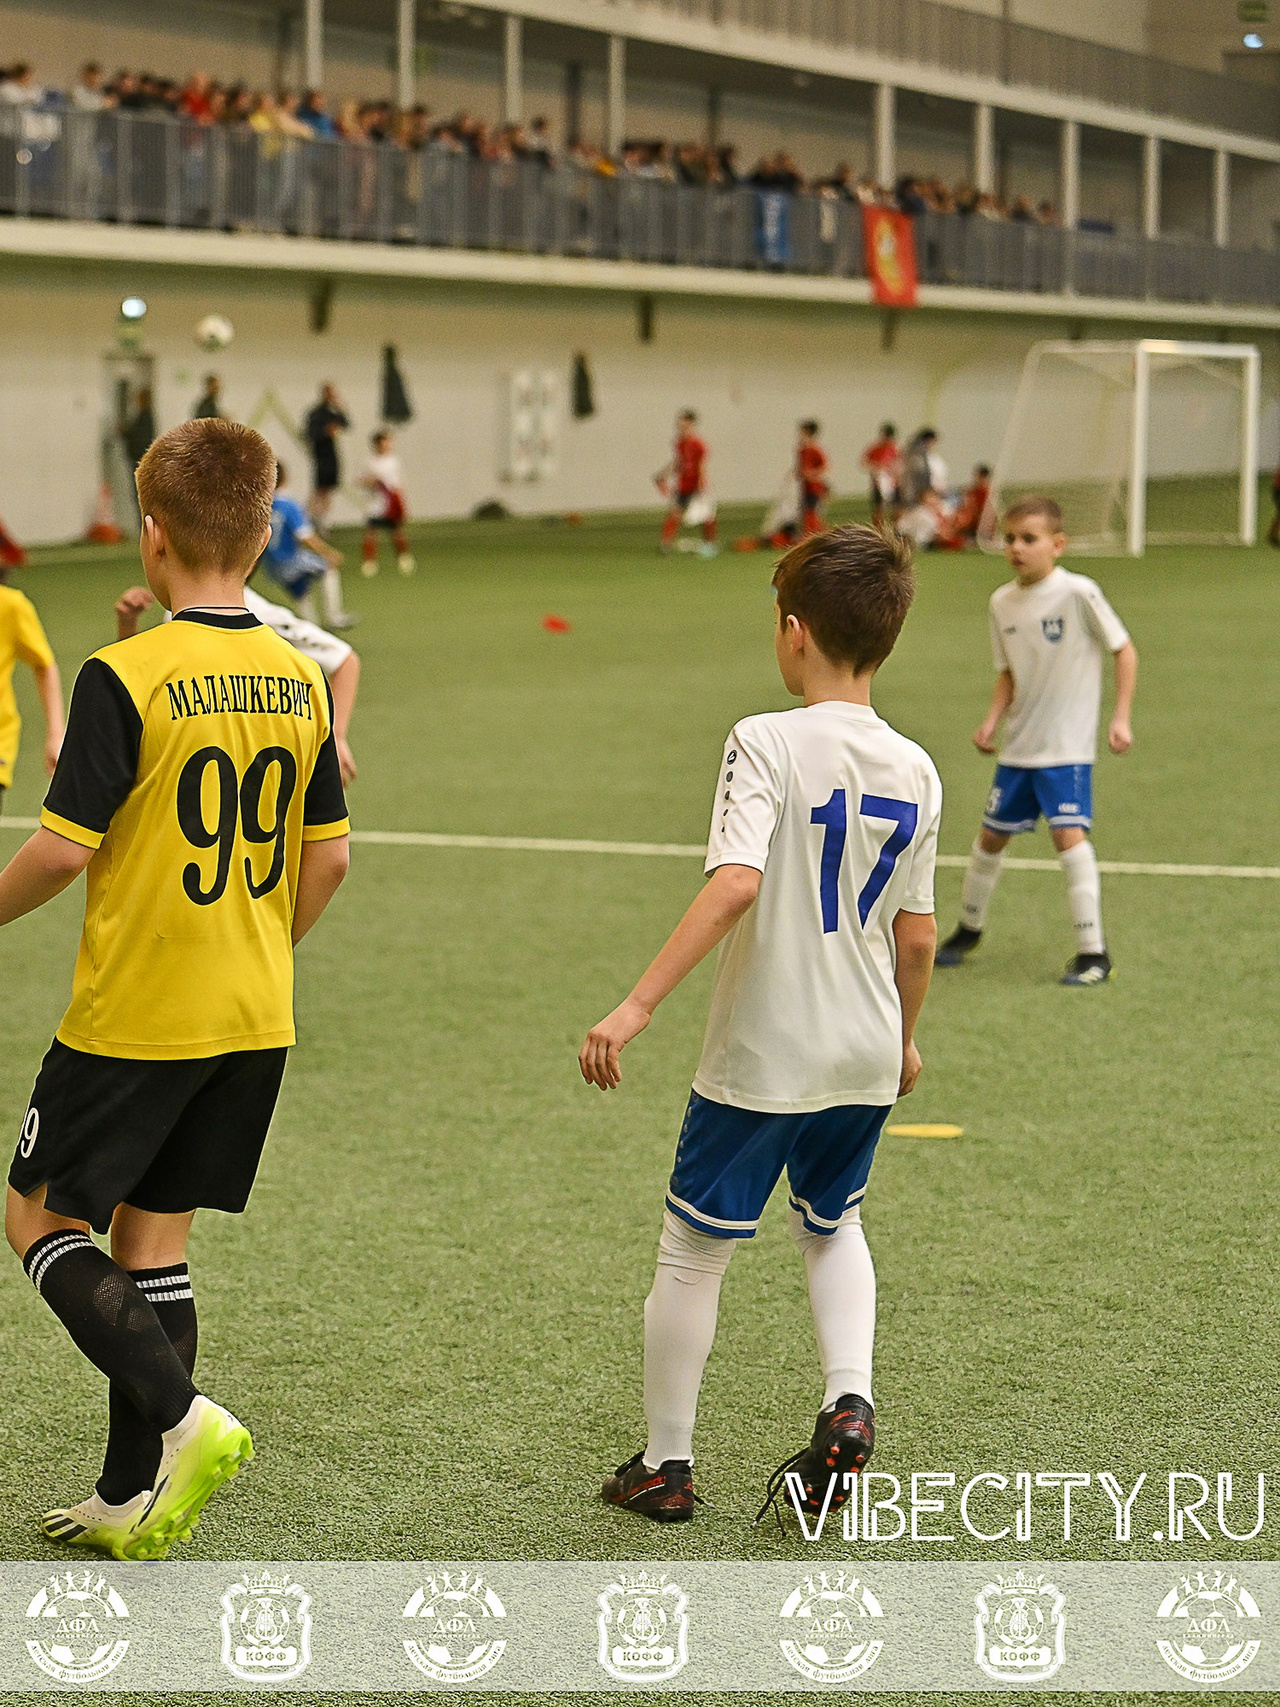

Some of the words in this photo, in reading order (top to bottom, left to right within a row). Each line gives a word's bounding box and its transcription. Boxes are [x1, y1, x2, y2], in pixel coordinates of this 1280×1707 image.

[166, 675, 312, 721] МАЛАШКЕВИЧ
[176, 746, 297, 906] 99
[811, 789, 918, 934] 17
